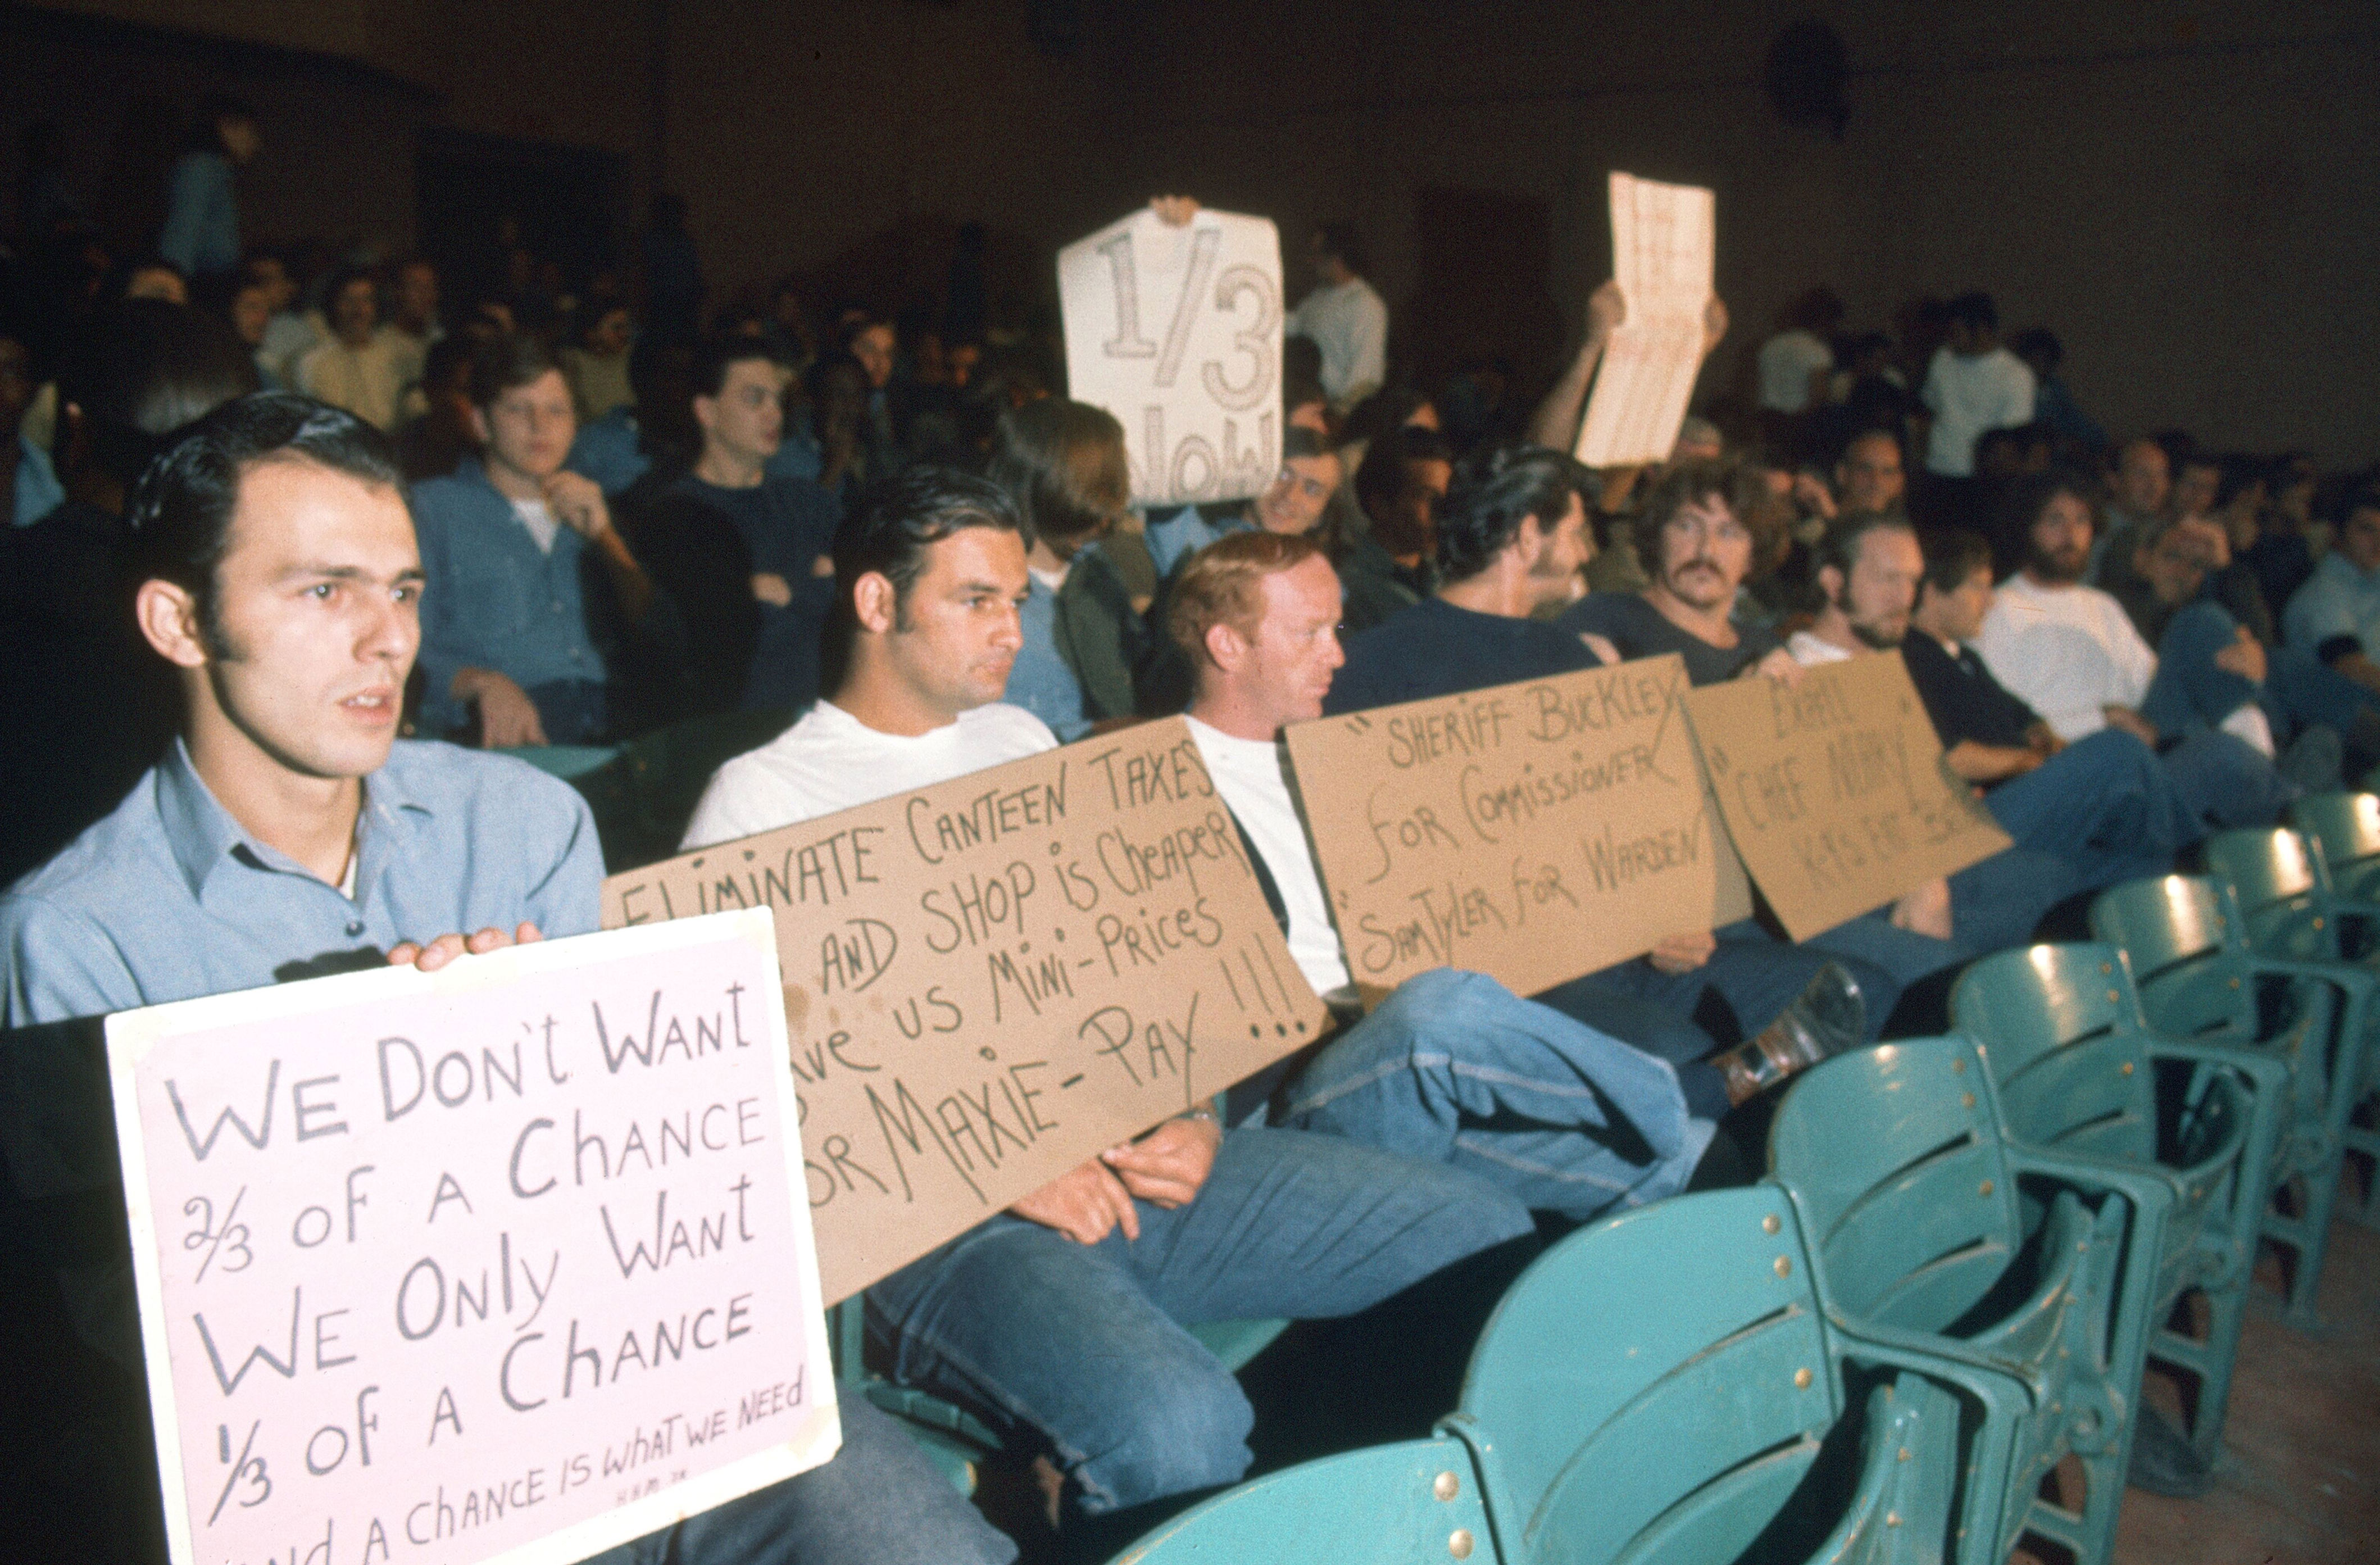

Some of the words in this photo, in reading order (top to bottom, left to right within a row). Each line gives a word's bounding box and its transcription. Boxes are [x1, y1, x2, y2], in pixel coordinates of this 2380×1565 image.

[1095, 227, 1283, 412] 1/3
[906, 761, 1067, 864] CANTEEN
[1088, 740, 1215, 811] TAXES
[922, 862, 1037, 952] SHOP
[165, 1059, 349, 1162] WE
[183, 1185, 254, 1284] 2/3
[428, 1173, 474, 1223] A
[193, 1286, 358, 1396] WE
[208, 1419, 273, 1527] 1/3
[429, 1386, 464, 1446] A
[363, 1517, 390, 1565] A
[561, 1454, 591, 1495] IS
[684, 1410, 728, 1449] WE
